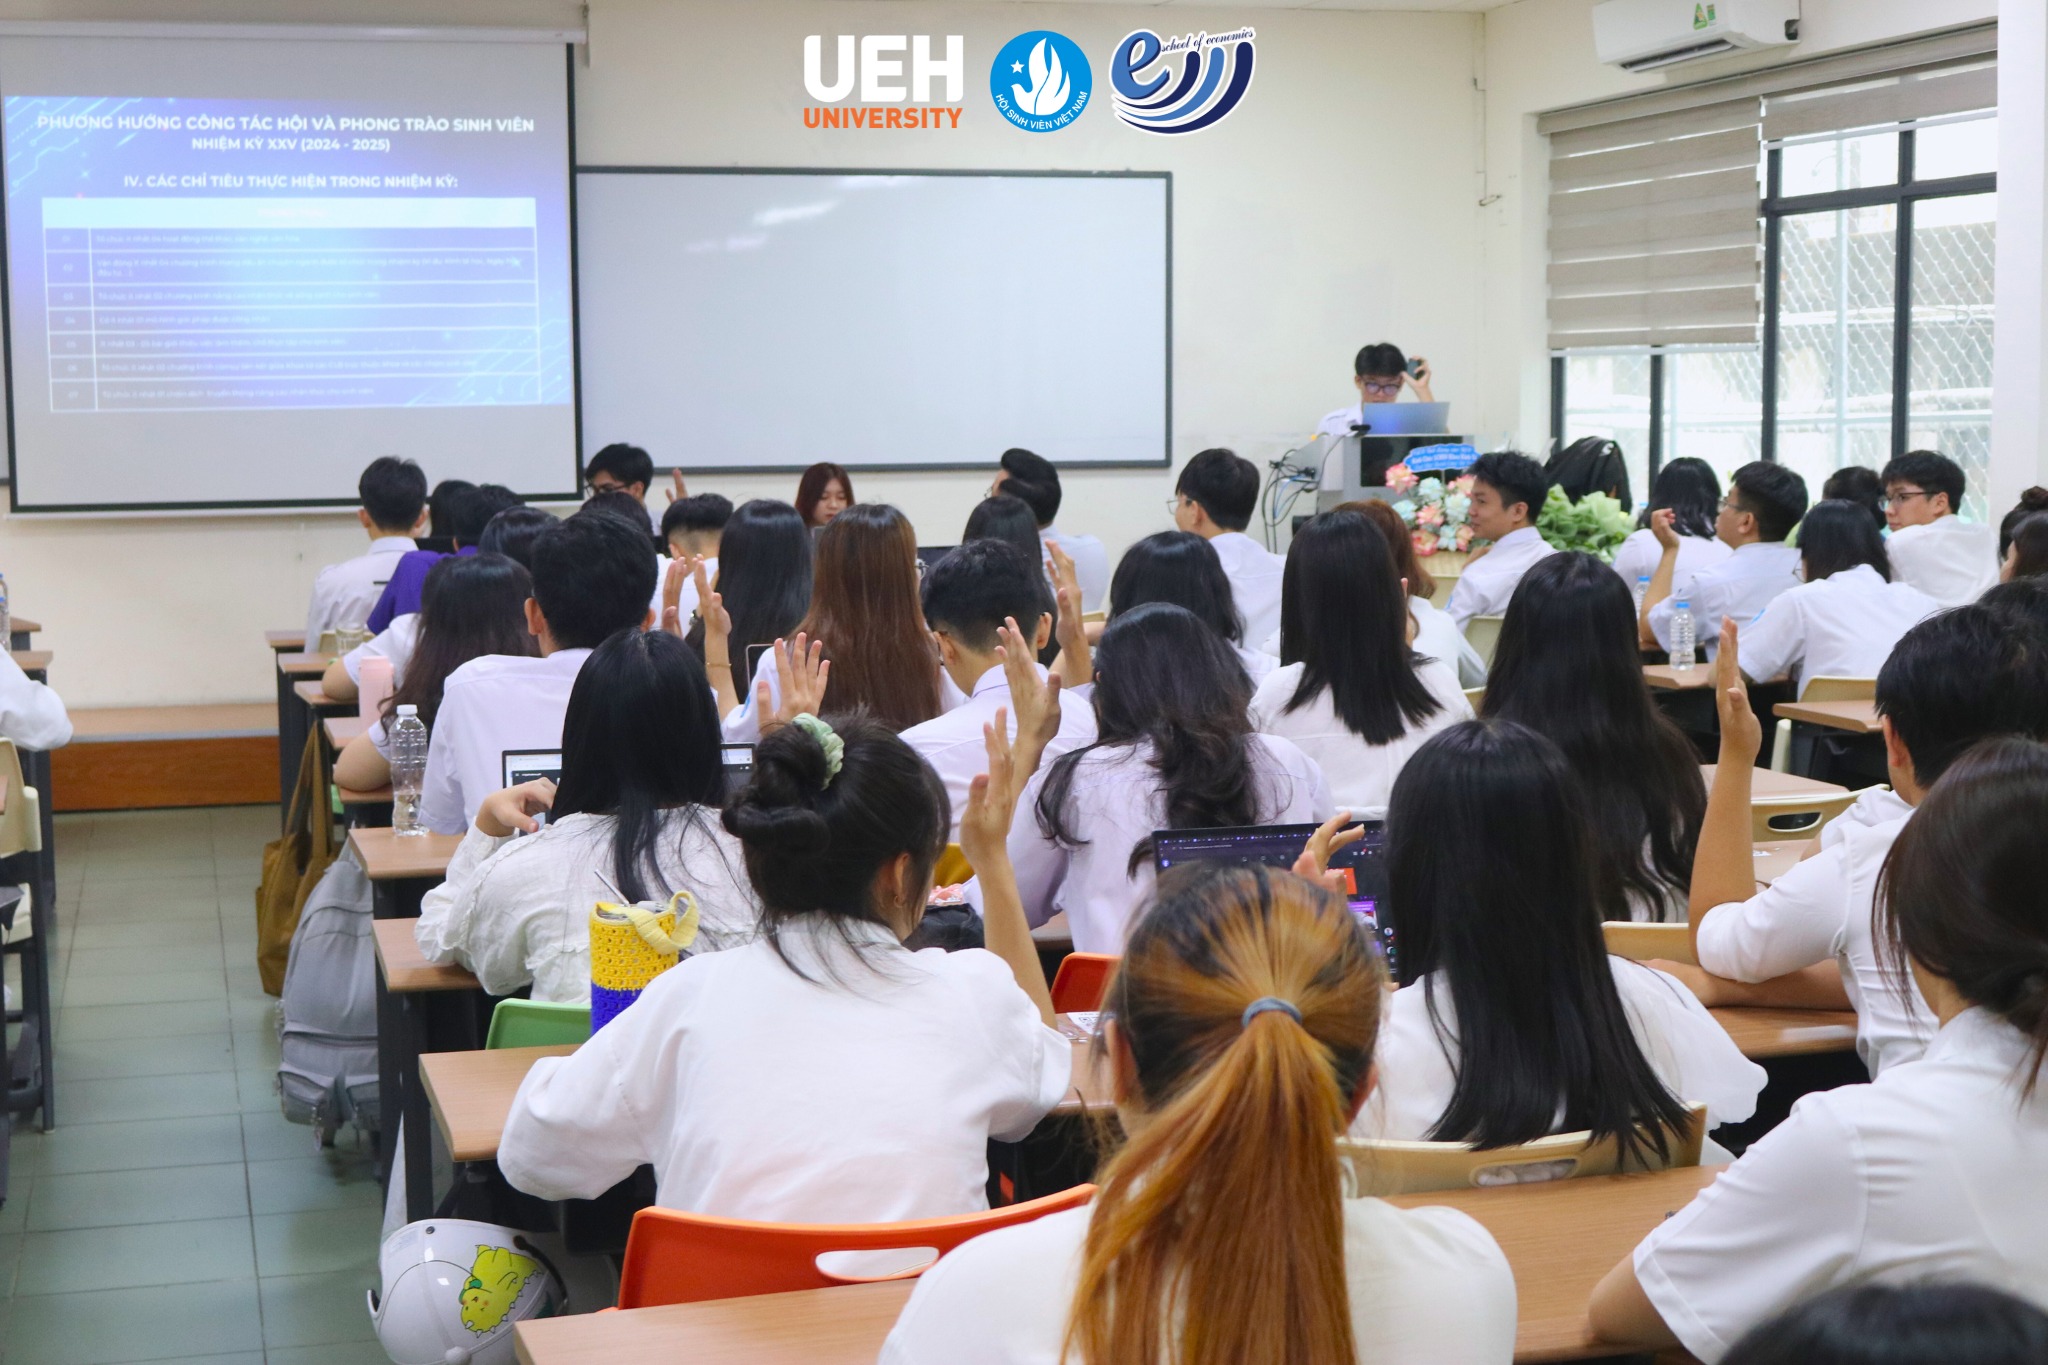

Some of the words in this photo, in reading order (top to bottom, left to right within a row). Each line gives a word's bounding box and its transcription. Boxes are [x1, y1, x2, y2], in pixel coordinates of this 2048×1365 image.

[37, 113, 113, 130] PHƯƠNG
[118, 113, 182, 130] HƯỚNG
[186, 113, 235, 130] CÔNG
[239, 114, 273, 130] TÁC
[277, 114, 307, 133] HỘI
[312, 114, 336, 131] VÀ
[340, 117, 400, 131] PHONG
[404, 115, 449, 131] TRÀO
[453, 118, 492, 132] SINH
[495, 116, 535, 132] VIÊN
[192, 135, 241, 152] NHIỆM
[245, 135, 263, 149] KỲ
[267, 138, 297, 150] XXV
[301, 138, 341, 152] (2024
[353, 138, 391, 152] 2025)
[124, 175, 143, 187] IV.
[146, 173, 177, 188] CÁC
[210, 173, 243, 188] TIÊU
[247, 174, 288, 190] THỰC
[292, 173, 327, 189] HIỆN
[330, 175, 380, 188] TRONG
[384, 173, 432, 189] NHIỆM
